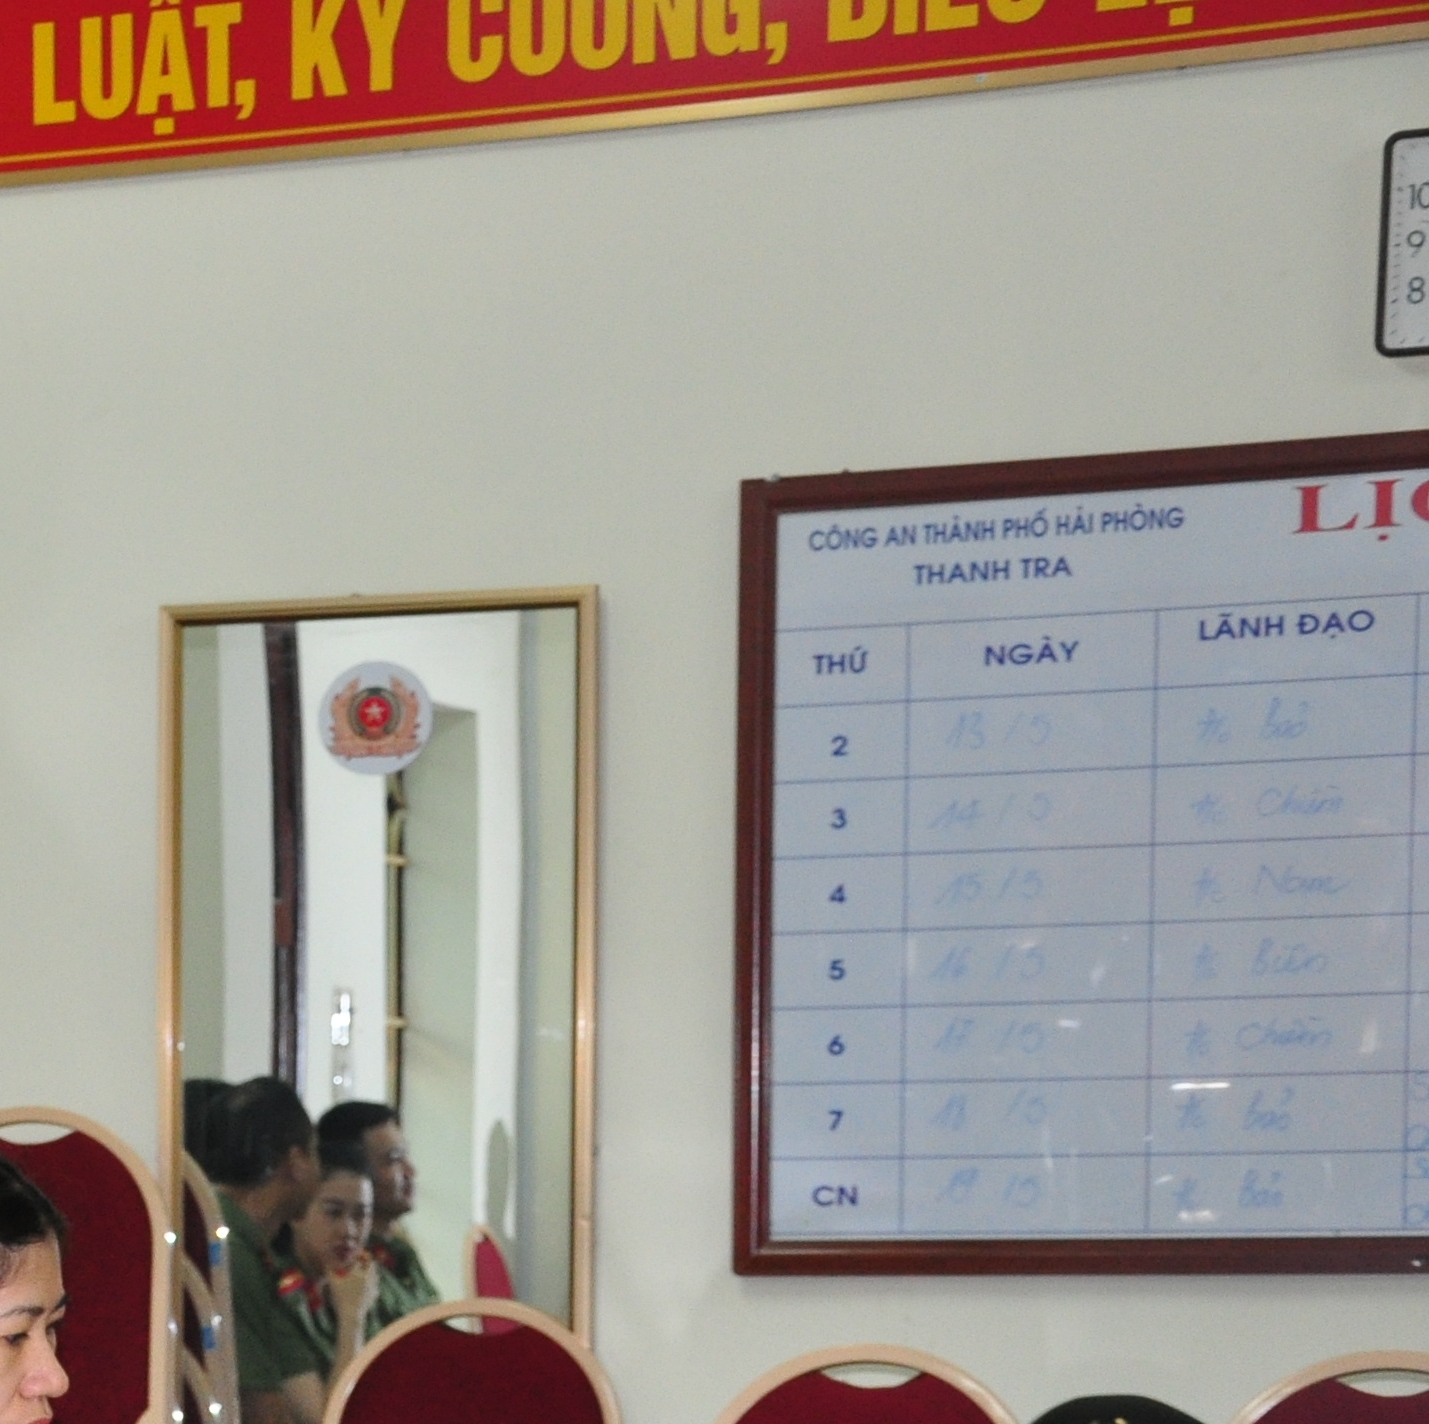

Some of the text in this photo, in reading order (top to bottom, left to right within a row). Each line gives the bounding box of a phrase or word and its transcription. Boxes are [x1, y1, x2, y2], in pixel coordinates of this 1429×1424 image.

[33, 0, 257, 136] LUẬT,
[1406, 229, 1426, 257] 9
[1406, 276, 1425, 304] 8
[808, 503, 1186, 552] CÔNG AN THÀNH PHỐ HẢI PHÒNG
[913, 555, 1074, 586] THANH TRA
[1198, 608, 1376, 642] LÃNH ĐẠO
[811, 646, 869, 675] THỨ
[983, 635, 1080, 667] NGÀY
[830, 735, 850, 757] 2
[830, 808, 848, 830] 3
[828, 884, 847, 905] 4
[828, 960, 847, 981] 5
[827, 1034, 846, 1056] 6
[827, 1111, 845, 1132] 7
[811, 1185, 859, 1208] CN
